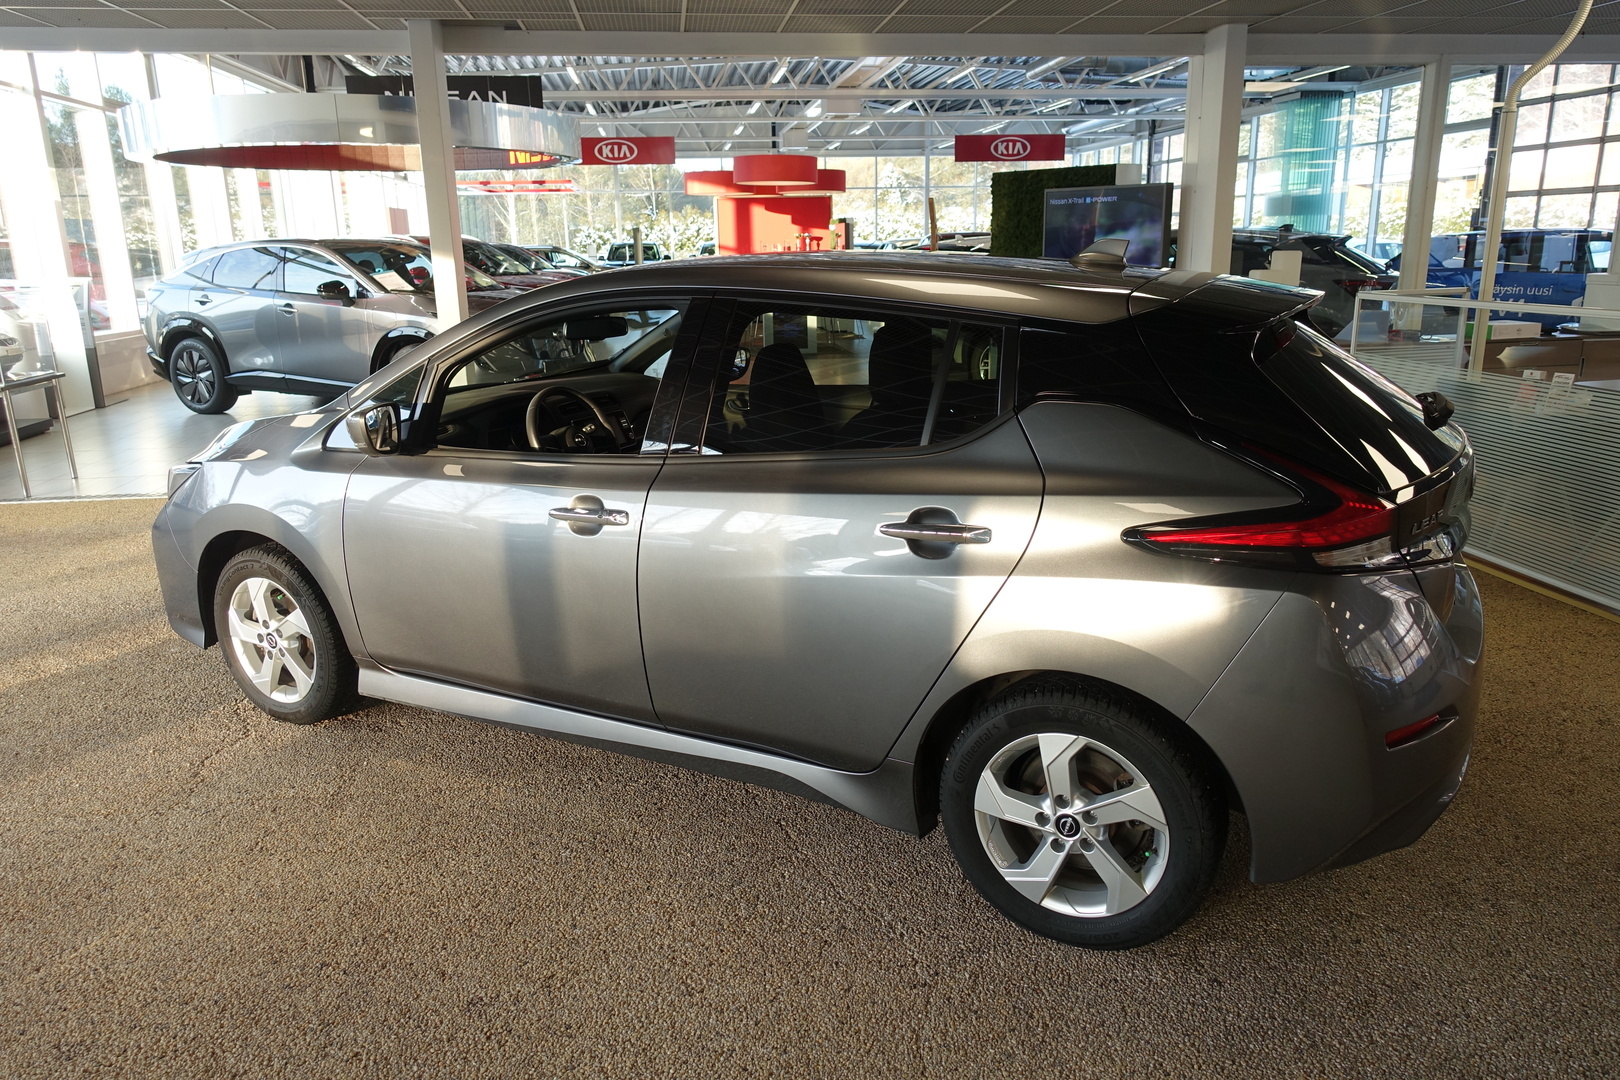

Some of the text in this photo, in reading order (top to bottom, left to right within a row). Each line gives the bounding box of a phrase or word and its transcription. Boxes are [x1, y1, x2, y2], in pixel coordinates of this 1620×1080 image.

[602, 144, 631, 158] KIA
[997, 142, 1024, 154] KIA
[1493, 284, 1553, 297] äysin uusi
[1411, 509, 1444, 535] LEAF
[953, 727, 994, 784] Continental
